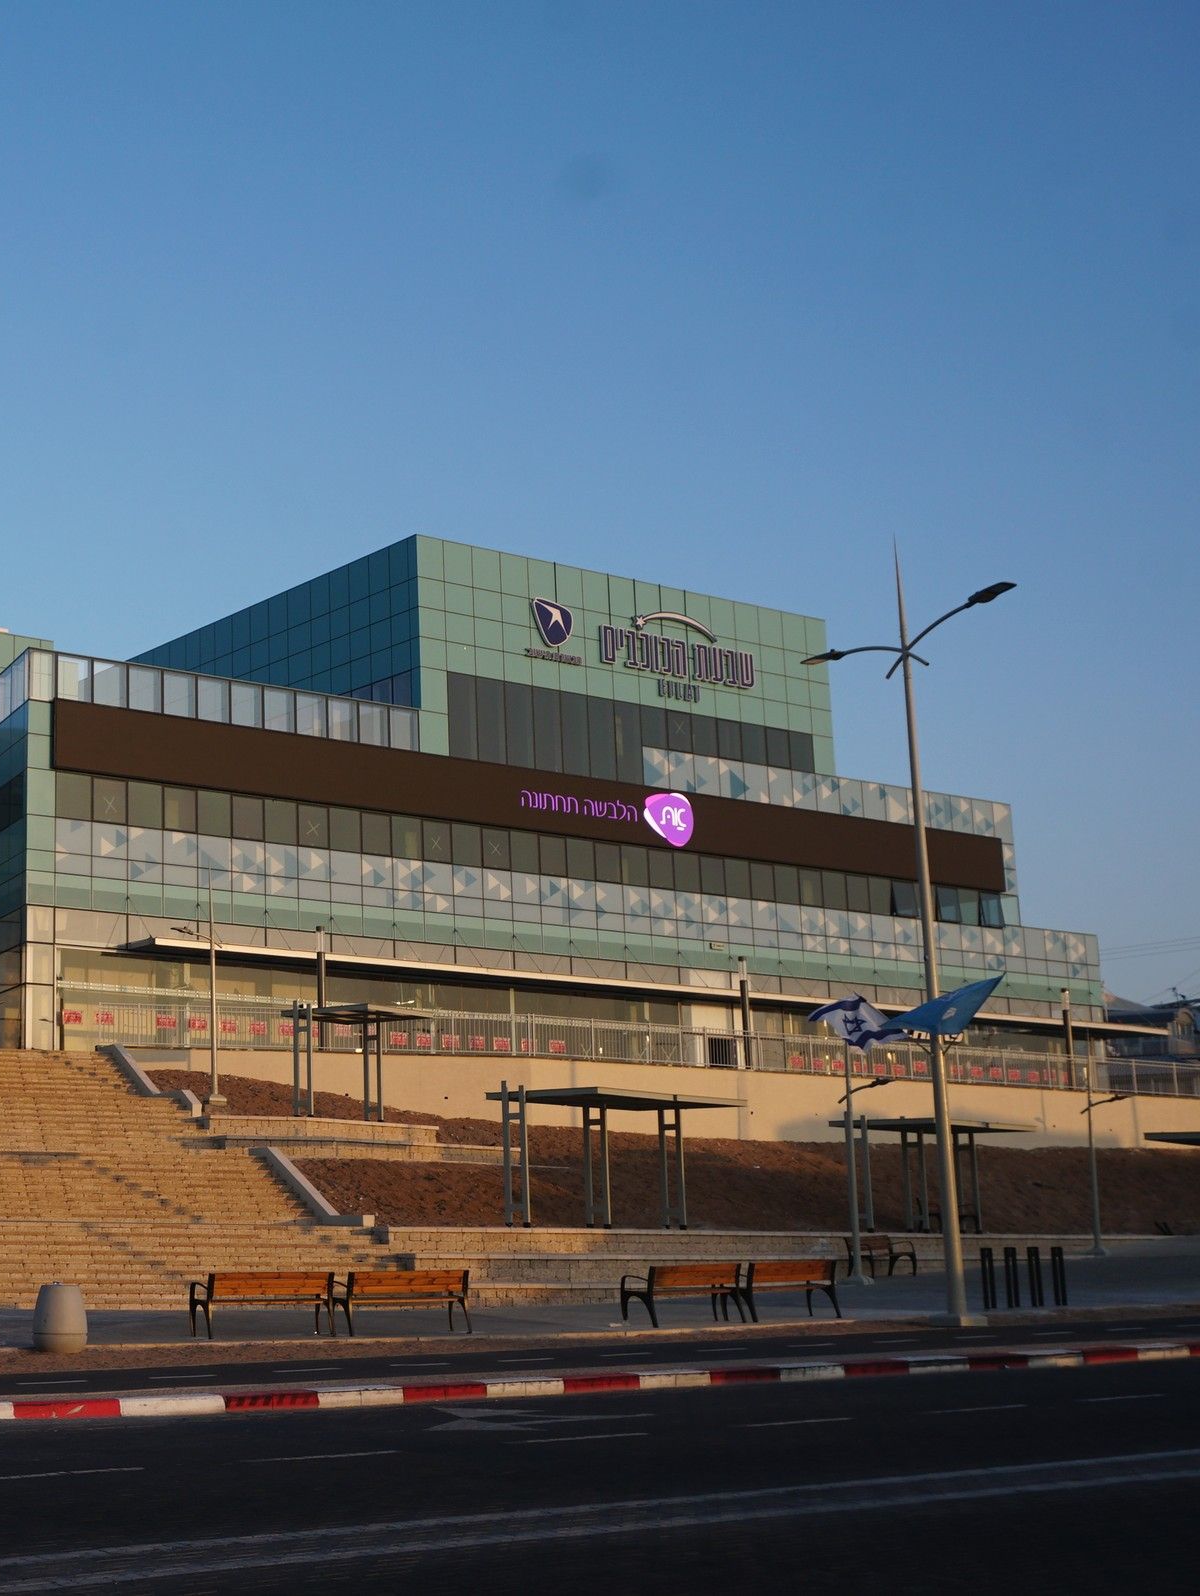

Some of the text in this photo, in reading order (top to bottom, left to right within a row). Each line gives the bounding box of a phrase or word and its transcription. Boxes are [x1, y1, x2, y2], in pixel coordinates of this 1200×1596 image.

[600, 624, 756, 689] שבעת הכוכבים
[658, 678, 700, 703] EILAT
[521, 790, 638, 822] הלבשה תחתונה
